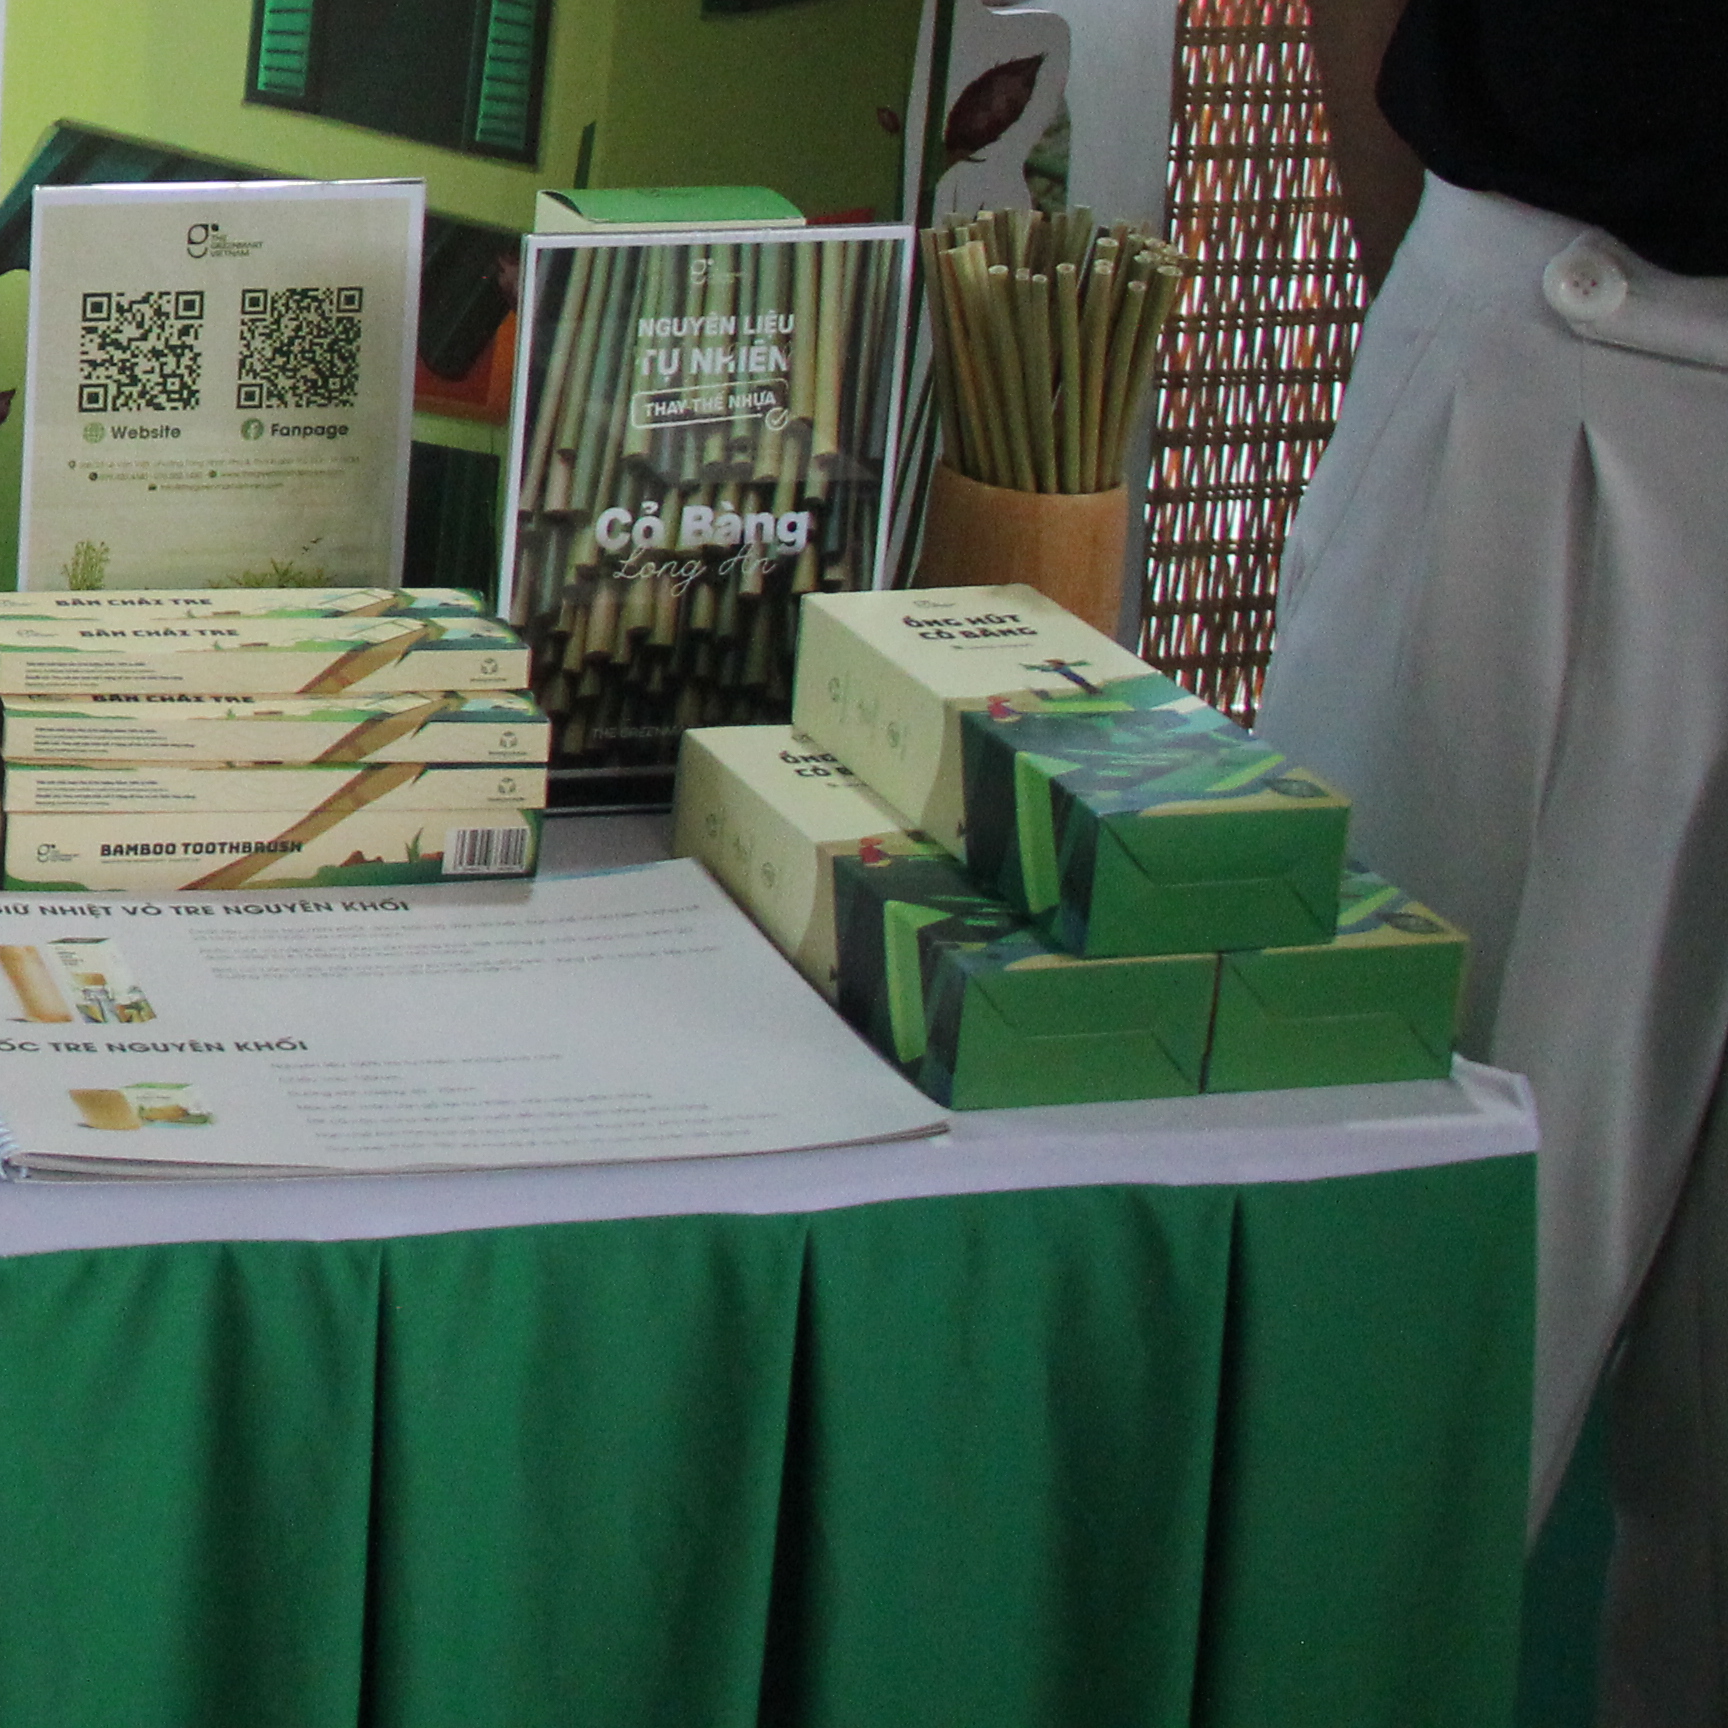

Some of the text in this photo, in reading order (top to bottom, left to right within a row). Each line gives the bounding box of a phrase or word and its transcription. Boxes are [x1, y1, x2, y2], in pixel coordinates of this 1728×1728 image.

[638, 309, 795, 339] NGUYÊN LIỆU
[690, 338, 790, 375] NHIÊN
[644, 400, 689, 418] THAY
[111, 424, 181, 440] Website
[271, 422, 349, 441] Fanpage
[596, 500, 811, 556] Cỏ Bàng
[613, 542, 777, 597] Long An
[100, 840, 304, 857] BAMBOO TOOTHBRUSH
[38, 901, 113, 918] NHIỆT
[121, 899, 163, 916] VỎ
[171, 904, 216, 916] TRE
[224, 899, 333, 916] NGUYÊN
[341, 897, 409, 913] KHỐI
[49, 1041, 98, 1054] TRE
[106, 1039, 226, 1054] NGUYÊN
[234, 1035, 308, 1053] KHỐI
